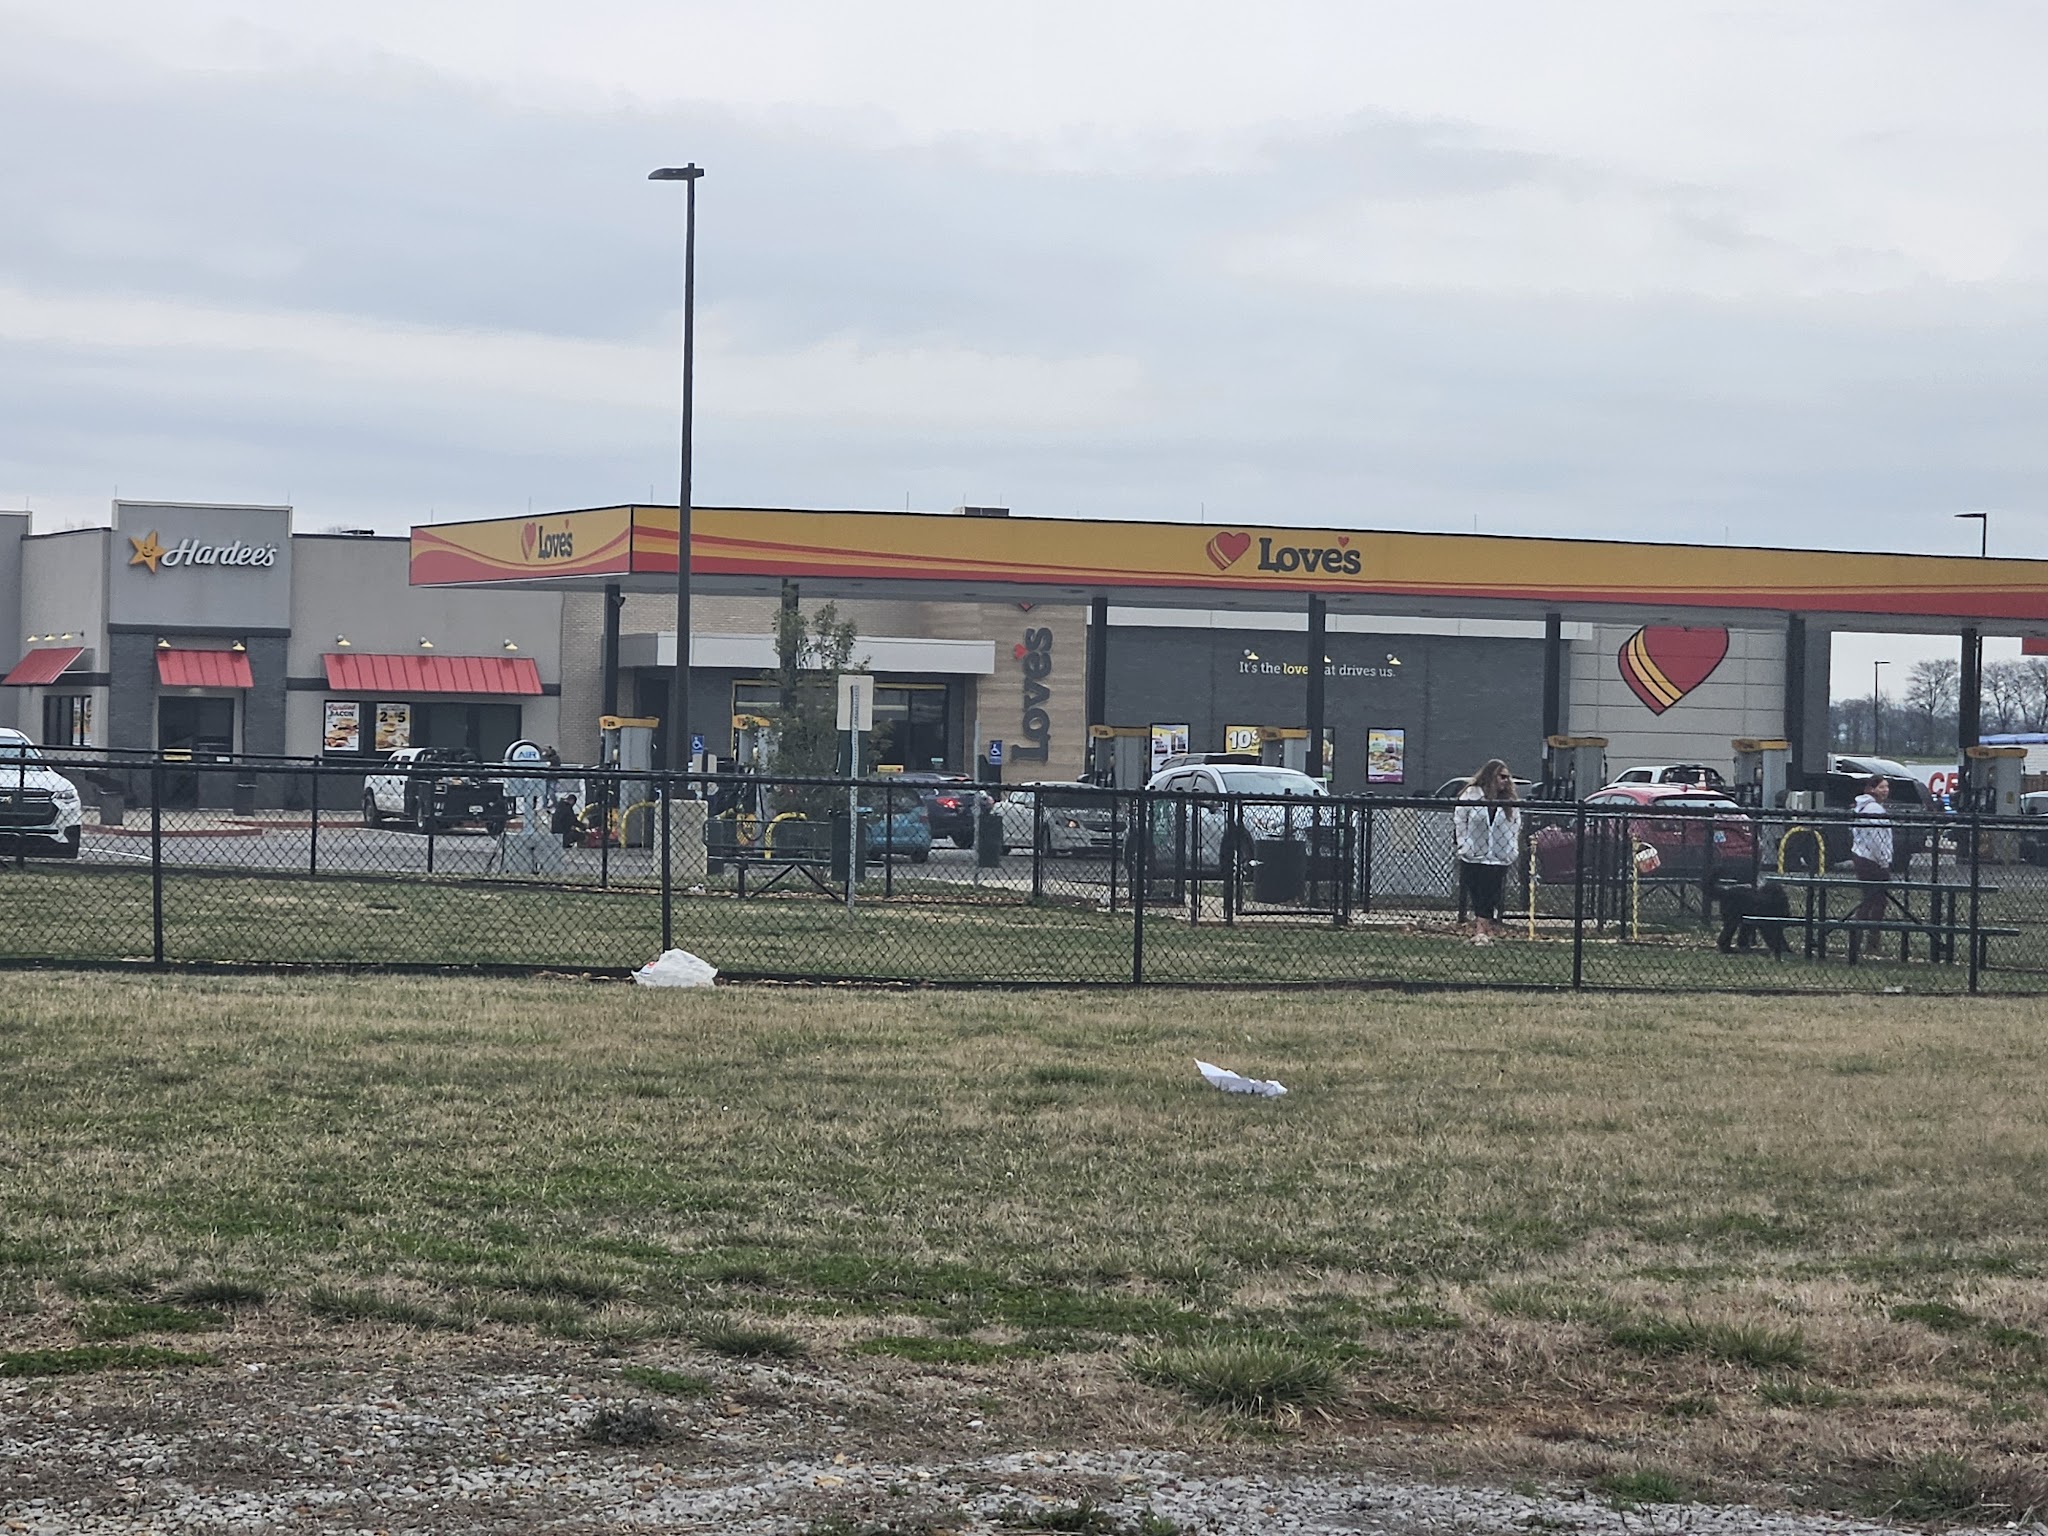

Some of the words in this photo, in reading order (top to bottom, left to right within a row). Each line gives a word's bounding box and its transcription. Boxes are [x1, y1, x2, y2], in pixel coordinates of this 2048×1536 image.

[161, 538, 277, 567] Hardee's
[538, 519, 573, 559] Love's
[1257, 536, 1362, 575] Love's
[1239, 661, 1258, 674] It's
[1260, 662, 1281, 674] the
[1282, 662, 1309, 675] love
[1324, 664, 1336, 676] at
[1339, 664, 1377, 677] drives
[1379, 668, 1397, 677] us.
[1011, 627, 1053, 766] Love's
[380, 711, 388, 722] 2
[517, 751, 537, 759] AIR
